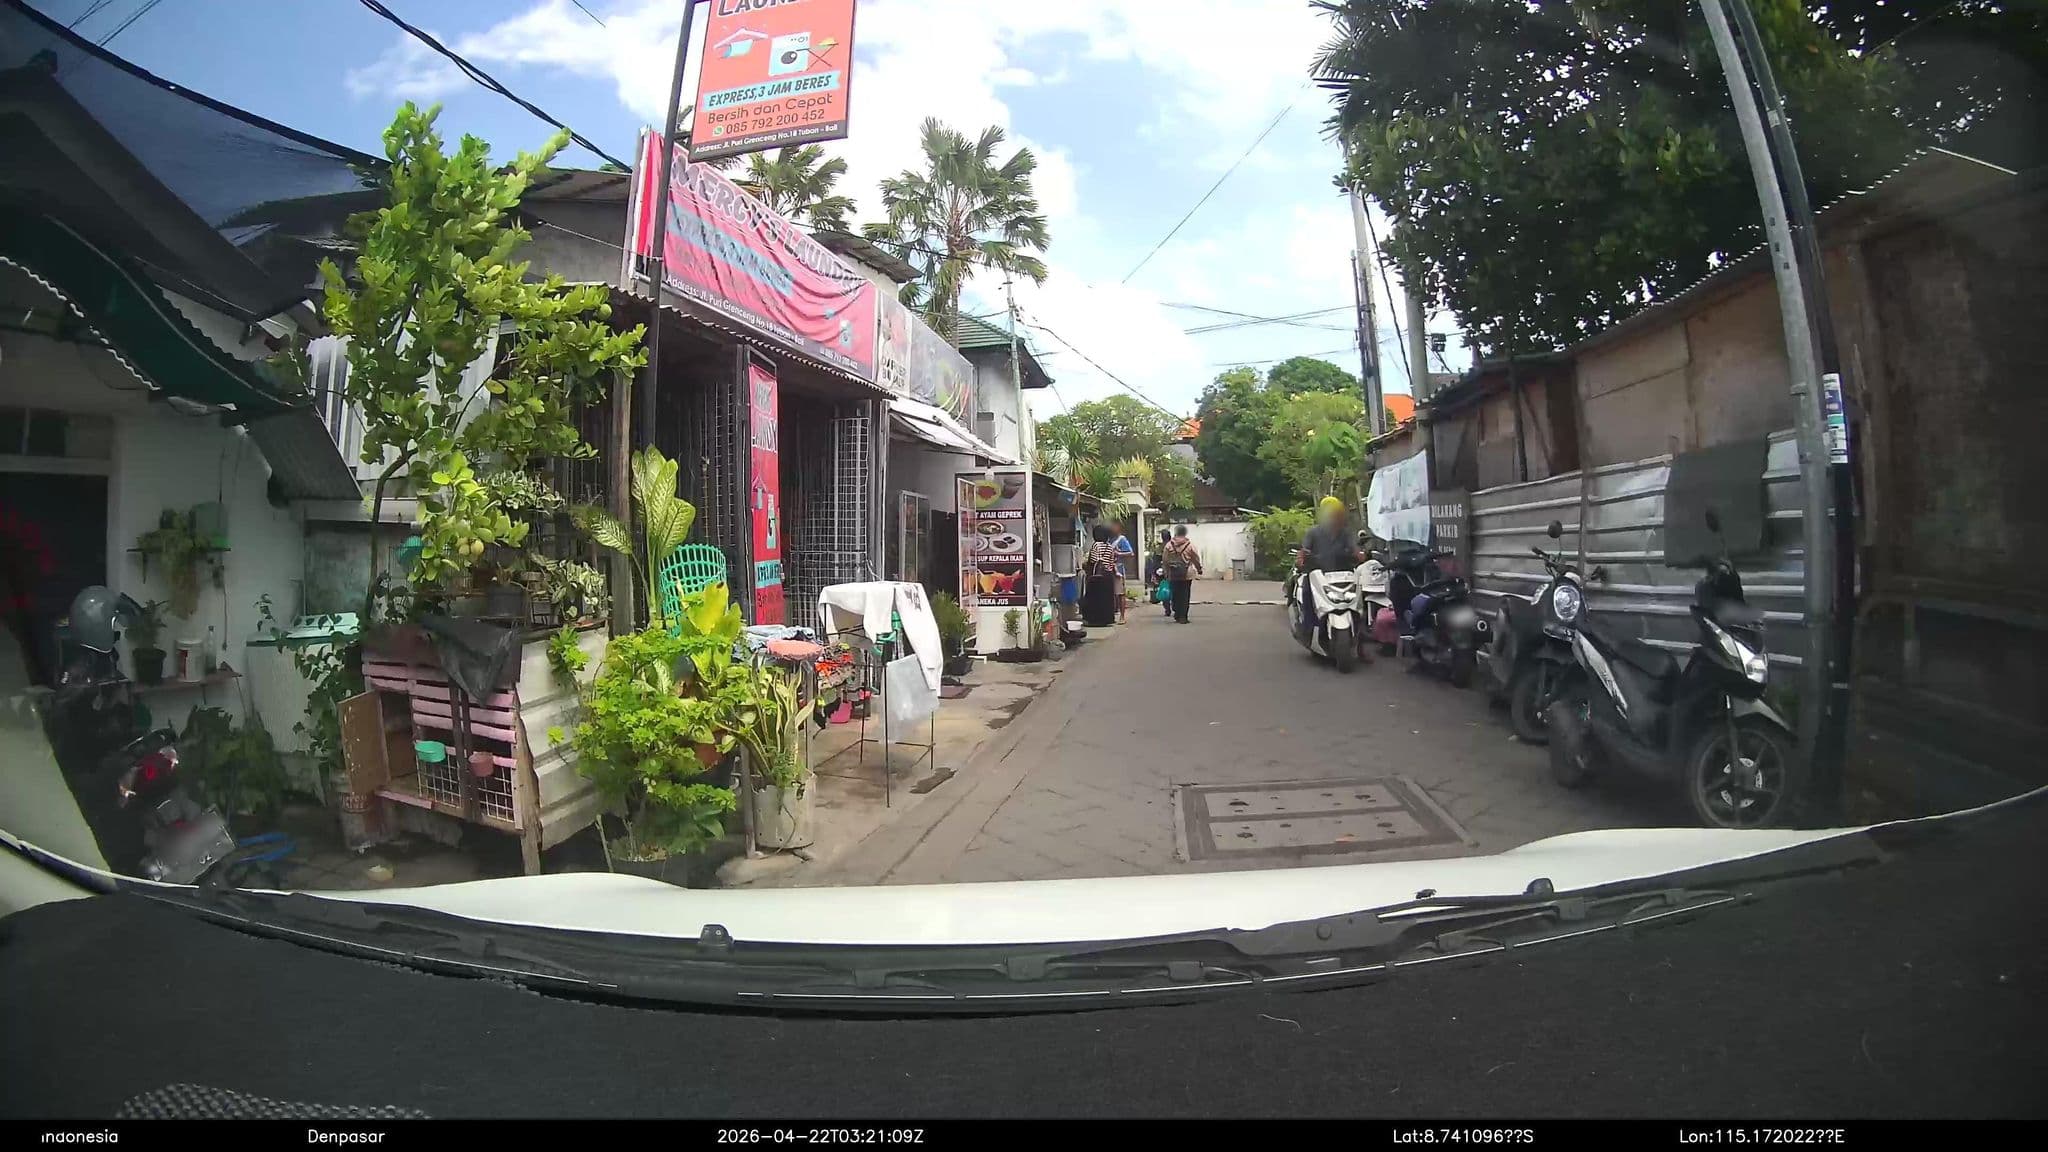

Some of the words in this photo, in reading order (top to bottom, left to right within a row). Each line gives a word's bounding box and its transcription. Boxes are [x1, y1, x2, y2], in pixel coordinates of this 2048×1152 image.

[767, 81, 793, 96] JAM
[794, 74, 832, 91] BERES
[707, 107, 750, 125] Bersih
[753, 102, 781, 114] dan
[785, 92, 833, 110] Cepat
[726, 123, 748, 135] 085
[751, 117, 773, 130] 792
[776, 114, 799, 126] 200
[801, 108, 825, 122] 452
[665, 274, 698, 296] Address:
[723, 300, 756, 324] Grenceng
[980, 511, 998, 519] AYAM
[998, 511, 1022, 519] GEPREK
